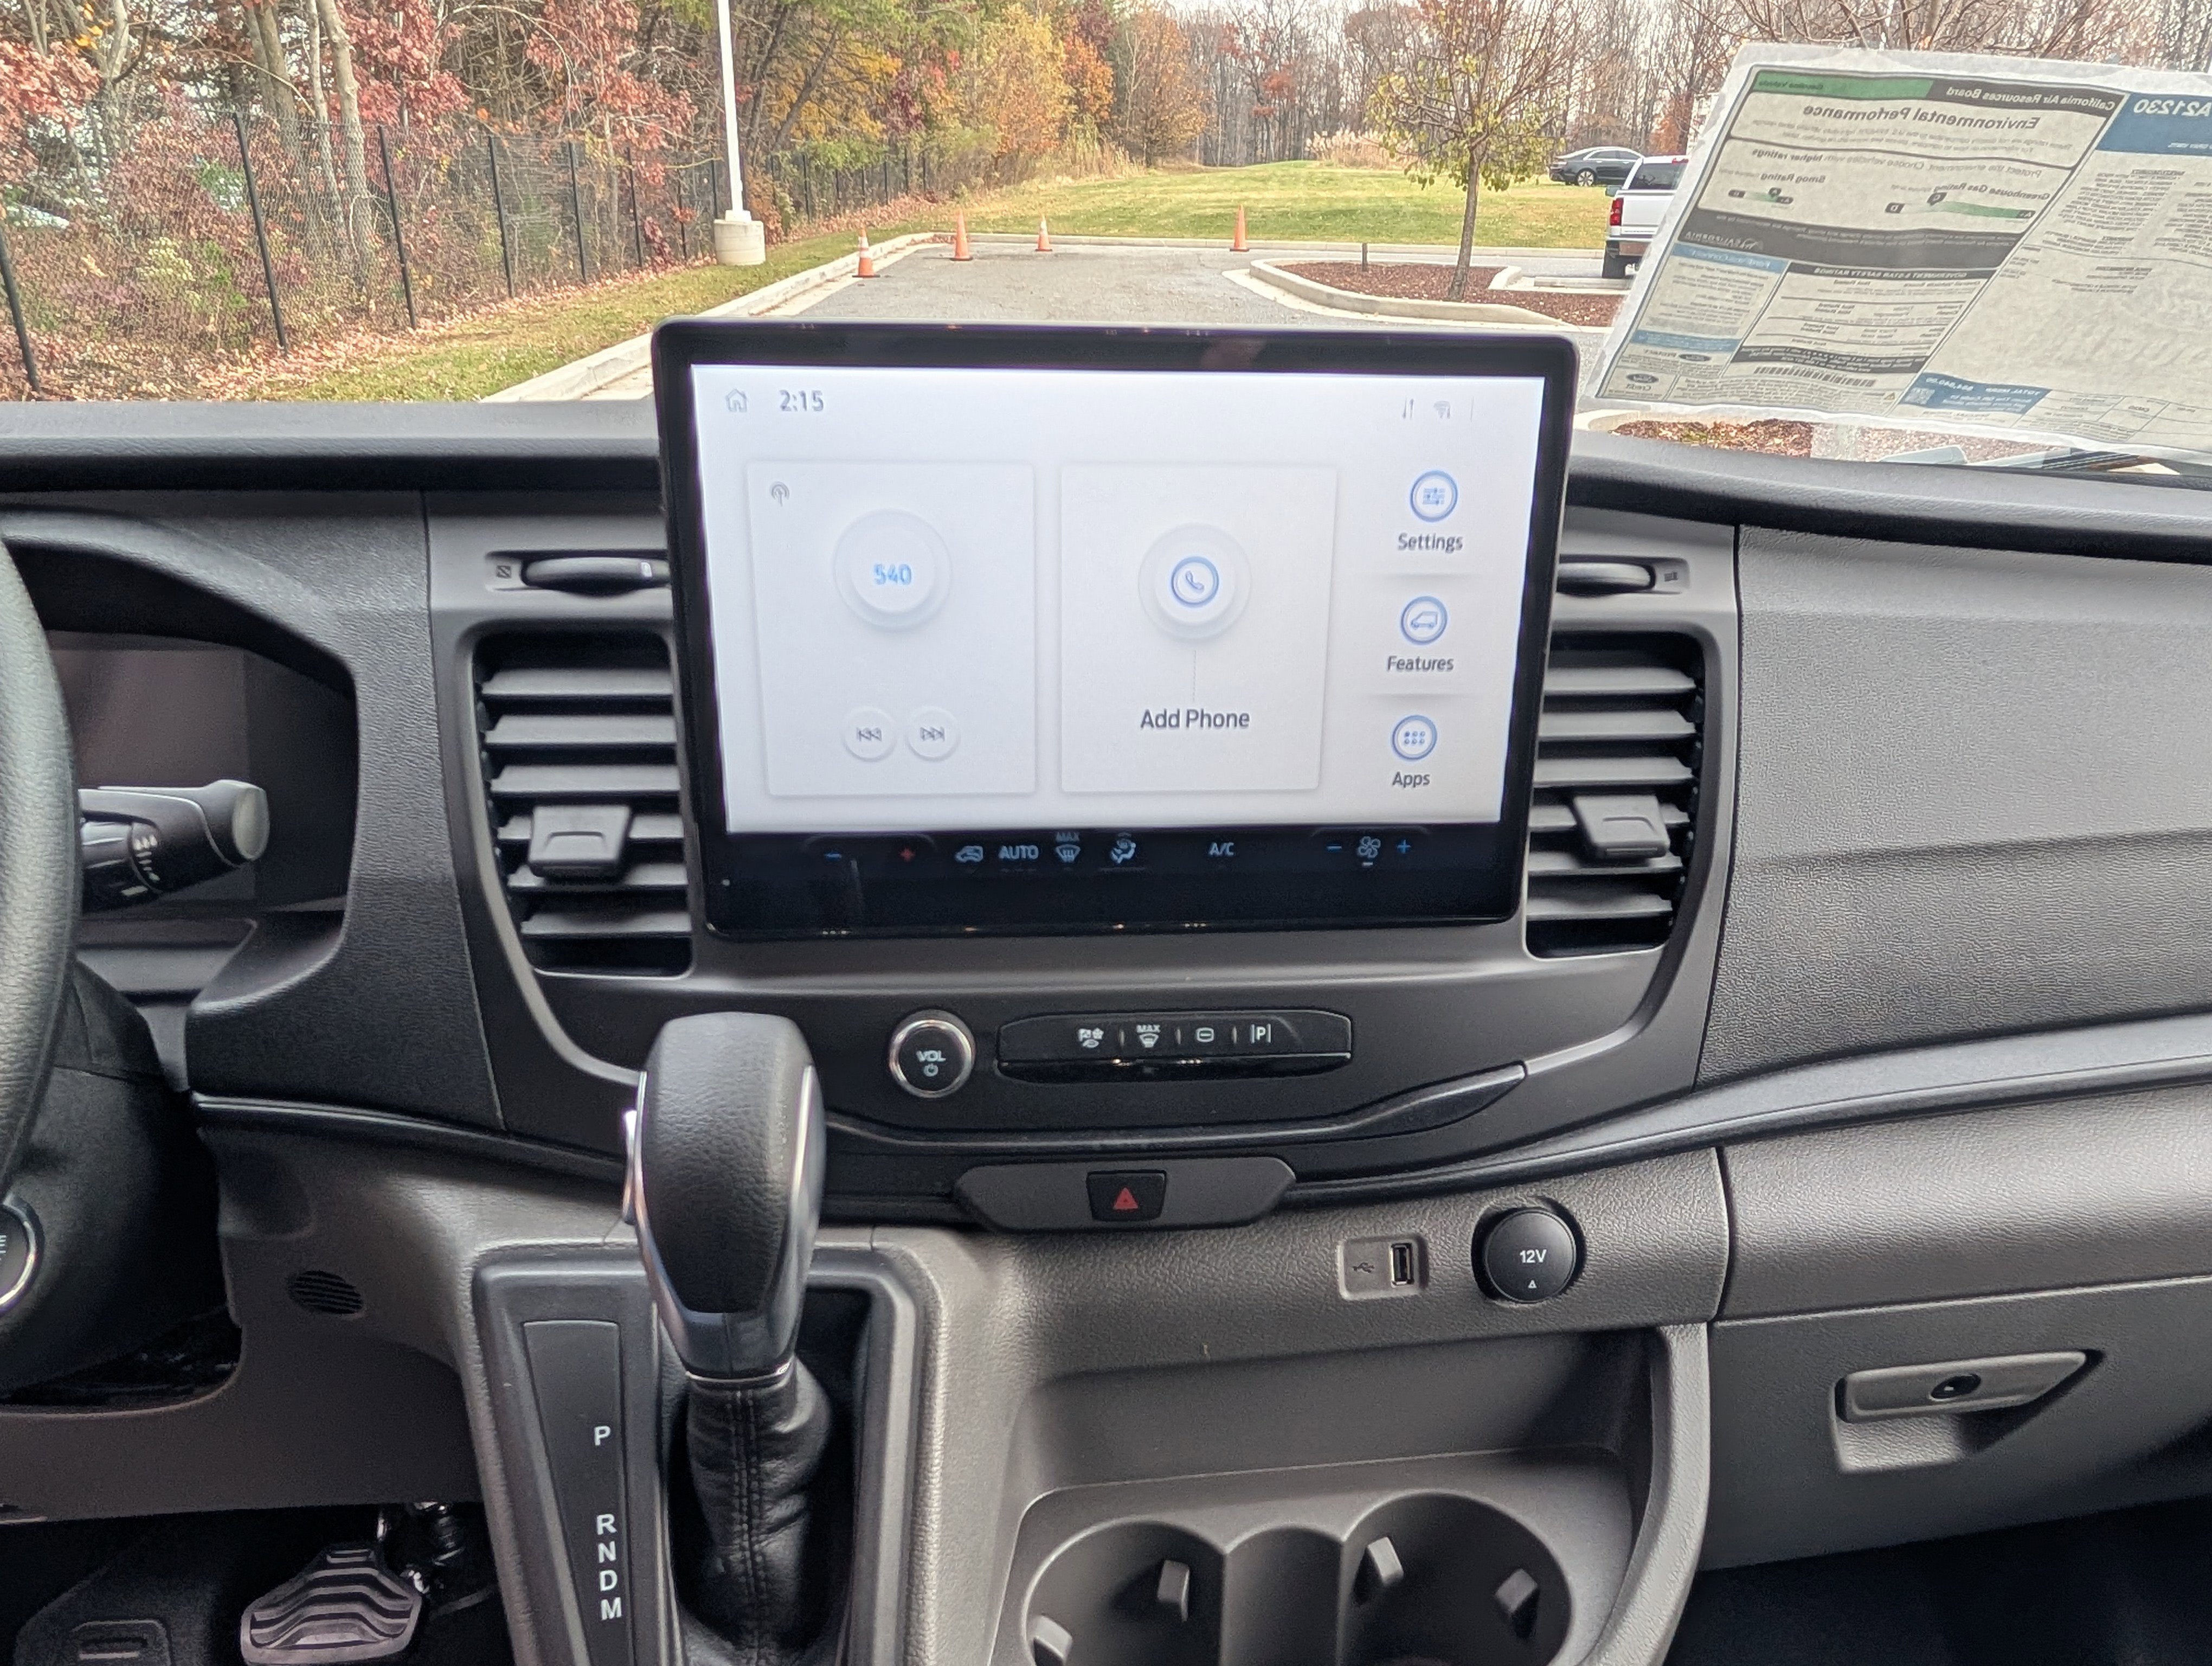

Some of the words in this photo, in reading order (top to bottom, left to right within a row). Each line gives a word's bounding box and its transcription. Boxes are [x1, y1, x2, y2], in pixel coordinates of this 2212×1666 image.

[779, 389, 825, 413] 2:15
[1398, 533, 1464, 553] Settings
[873, 563, 913, 586] 540
[1386, 655, 1455, 672] Features
[1140, 709, 1180, 730] Add
[1185, 709, 1251, 730] Phone
[1392, 771, 1431, 789] Apps
[998, 844, 1039, 861] AUTO
[1208, 841, 1236, 857] A/C
[1136, 1024, 1160, 1033] MAX
[916, 1050, 946, 1062] VOL
[1520, 1248, 1547, 1264] 12V
[594, 1425, 611, 1446] P
[596, 1513, 618, 1535] R
[597, 1540, 617, 1564] N
[599, 1570, 618, 1592] D
[601, 1597, 622, 1620] M
